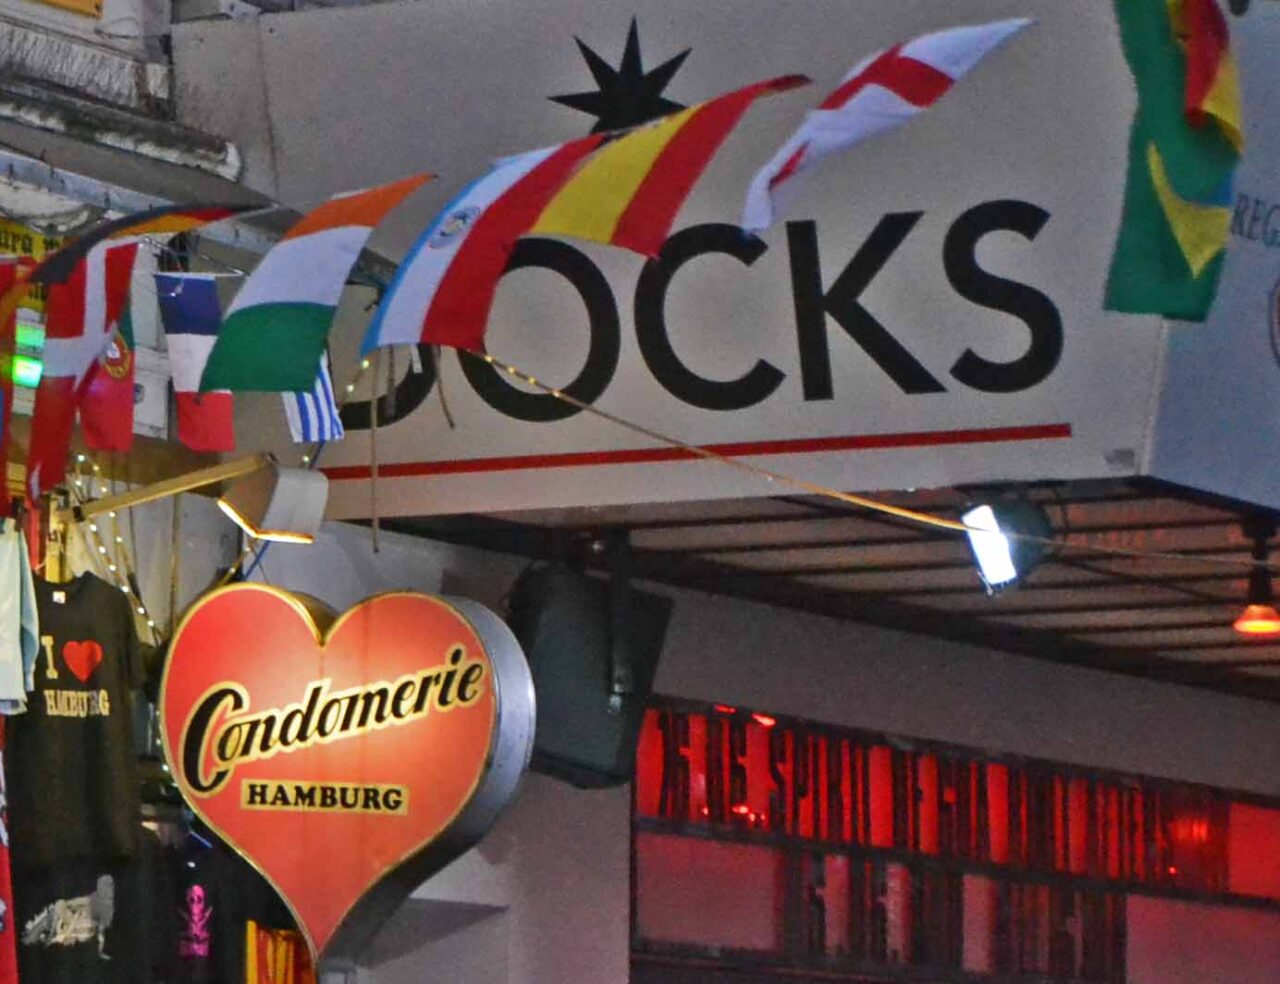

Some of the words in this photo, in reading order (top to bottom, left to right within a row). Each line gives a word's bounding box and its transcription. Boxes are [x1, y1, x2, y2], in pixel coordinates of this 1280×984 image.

[41, 635, 59, 679] I
[183, 648, 484, 793] Condomerie
[248, 783, 404, 812] HAMBURG
